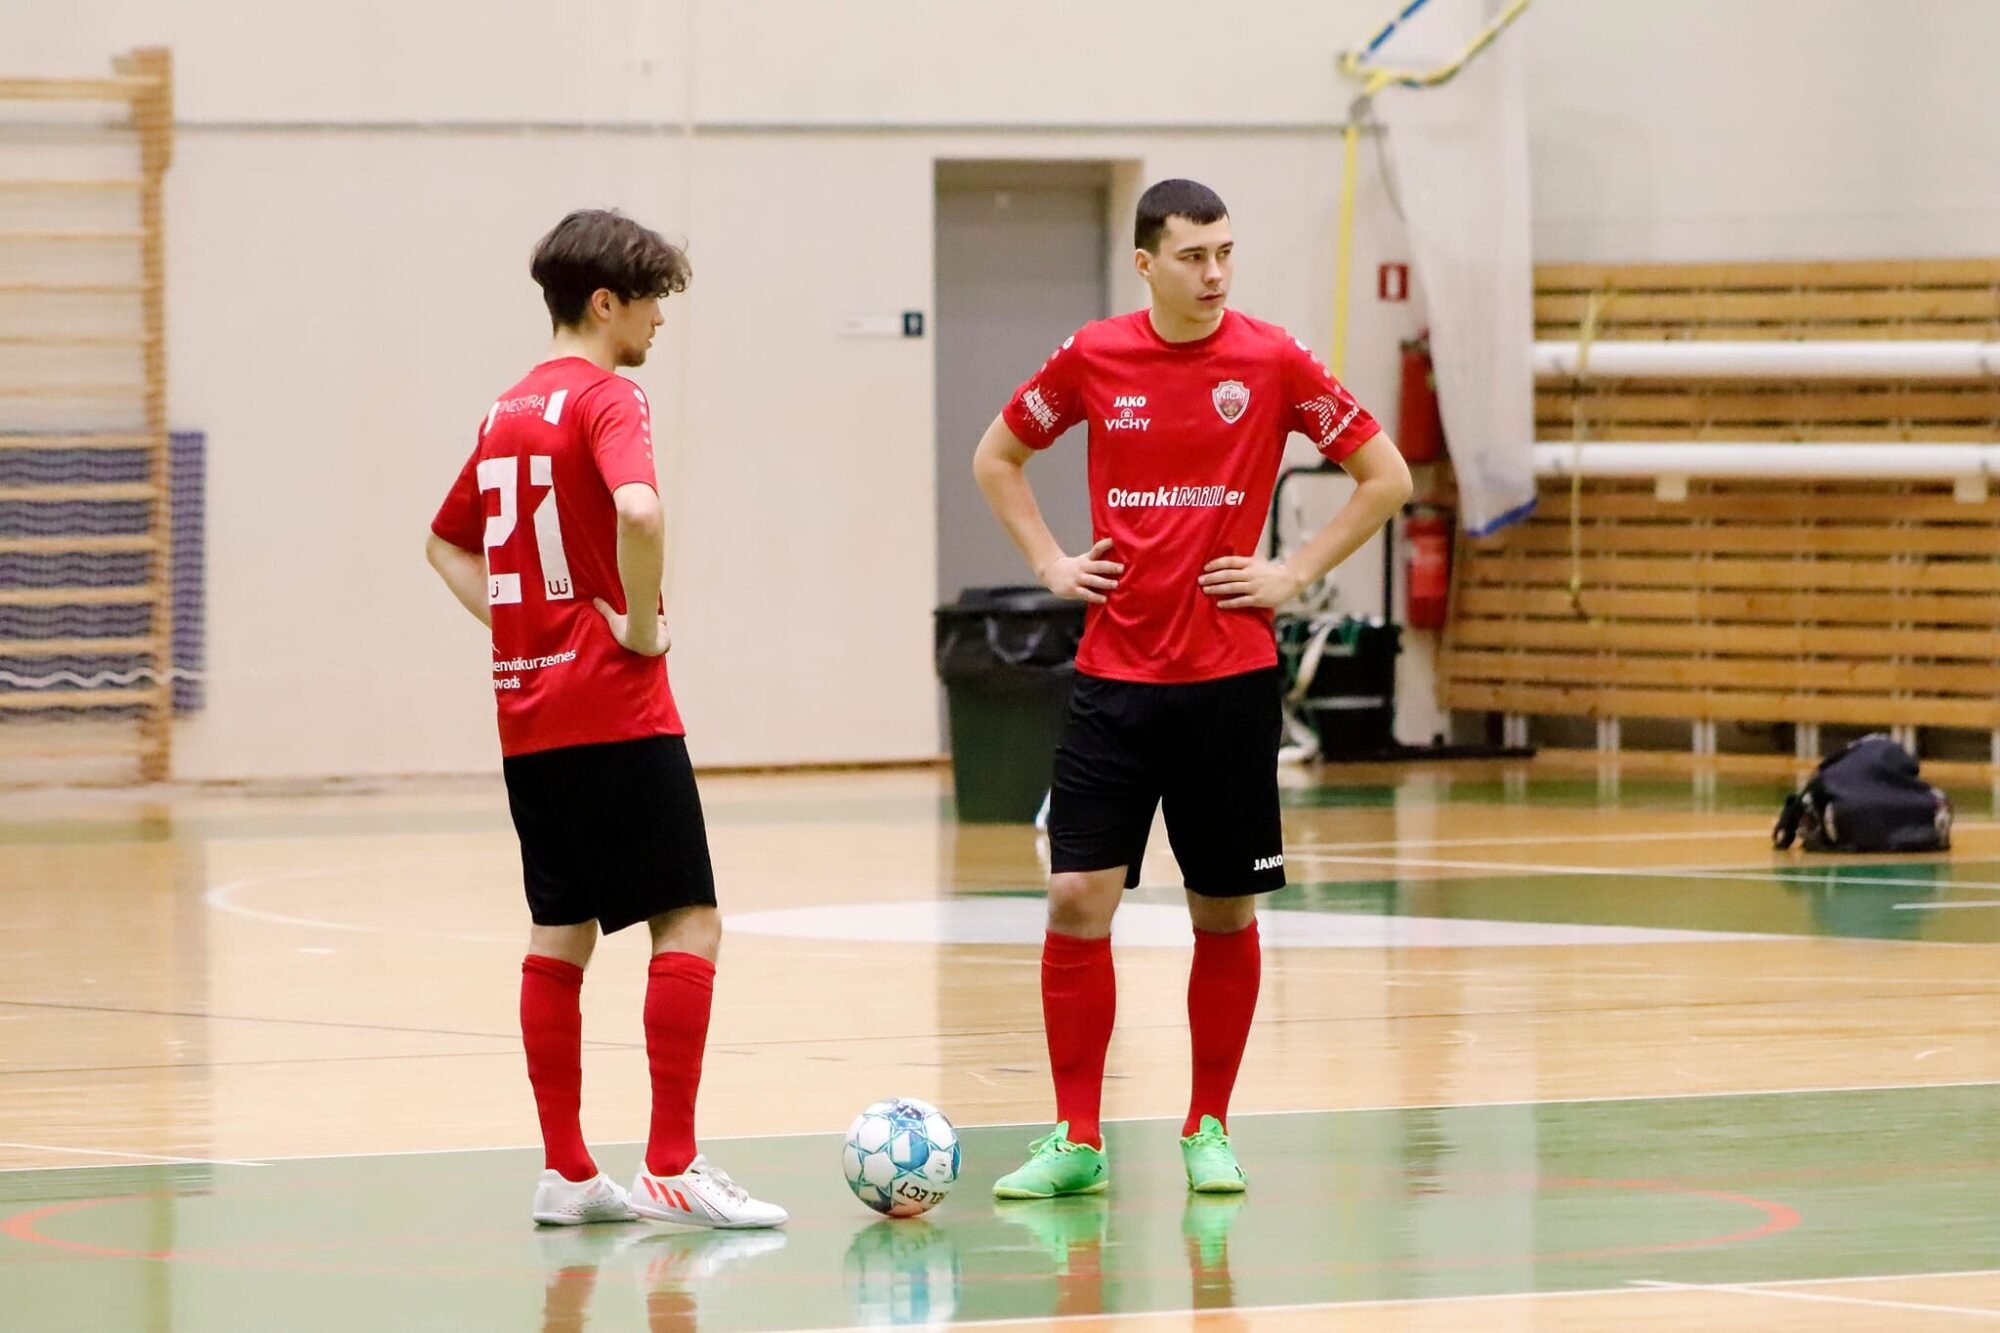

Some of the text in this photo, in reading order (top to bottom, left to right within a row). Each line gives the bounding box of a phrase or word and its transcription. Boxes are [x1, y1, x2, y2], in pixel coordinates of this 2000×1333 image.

[1113, 395, 1147, 408] JAKO
[1104, 418, 1151, 431] VICHY
[1317, 405, 1360, 449] KOMANDA
[1107, 485, 1246, 508] OtankiMiller
[476, 455, 574, 605] 21
[492, 649, 577, 673] envidkurzemes
[1253, 854, 1284, 871] JAKO
[896, 1181, 947, 1205] ELECT
